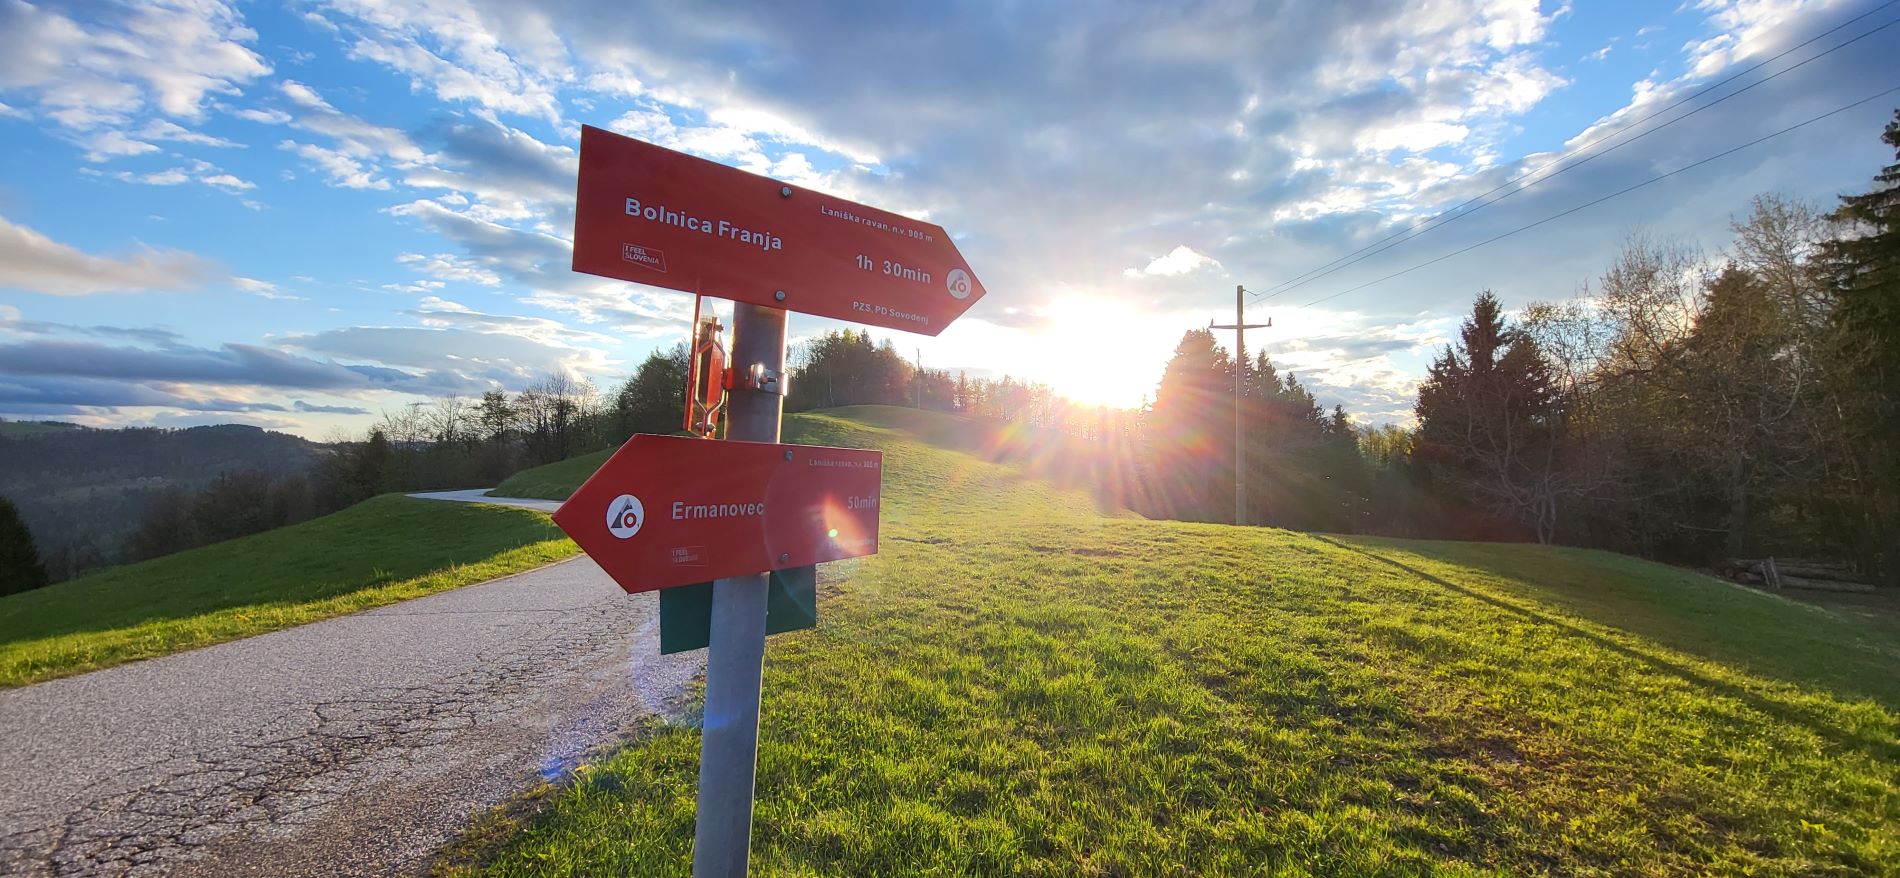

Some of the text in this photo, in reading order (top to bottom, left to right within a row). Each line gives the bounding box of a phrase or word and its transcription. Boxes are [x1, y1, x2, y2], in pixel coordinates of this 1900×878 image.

[625, 197, 782, 251] Bolnica Franja
[925, 234, 933, 242] m
[624, 252, 660, 265] SLOVENIA
[629, 246, 647, 255] FEEL
[856, 254, 931, 284] 1h 30min
[875, 305, 888, 315] PD
[889, 308, 929, 326] Sovodenj
[672, 501, 765, 520] Ermanovec
[847, 495, 877, 510] 50min
